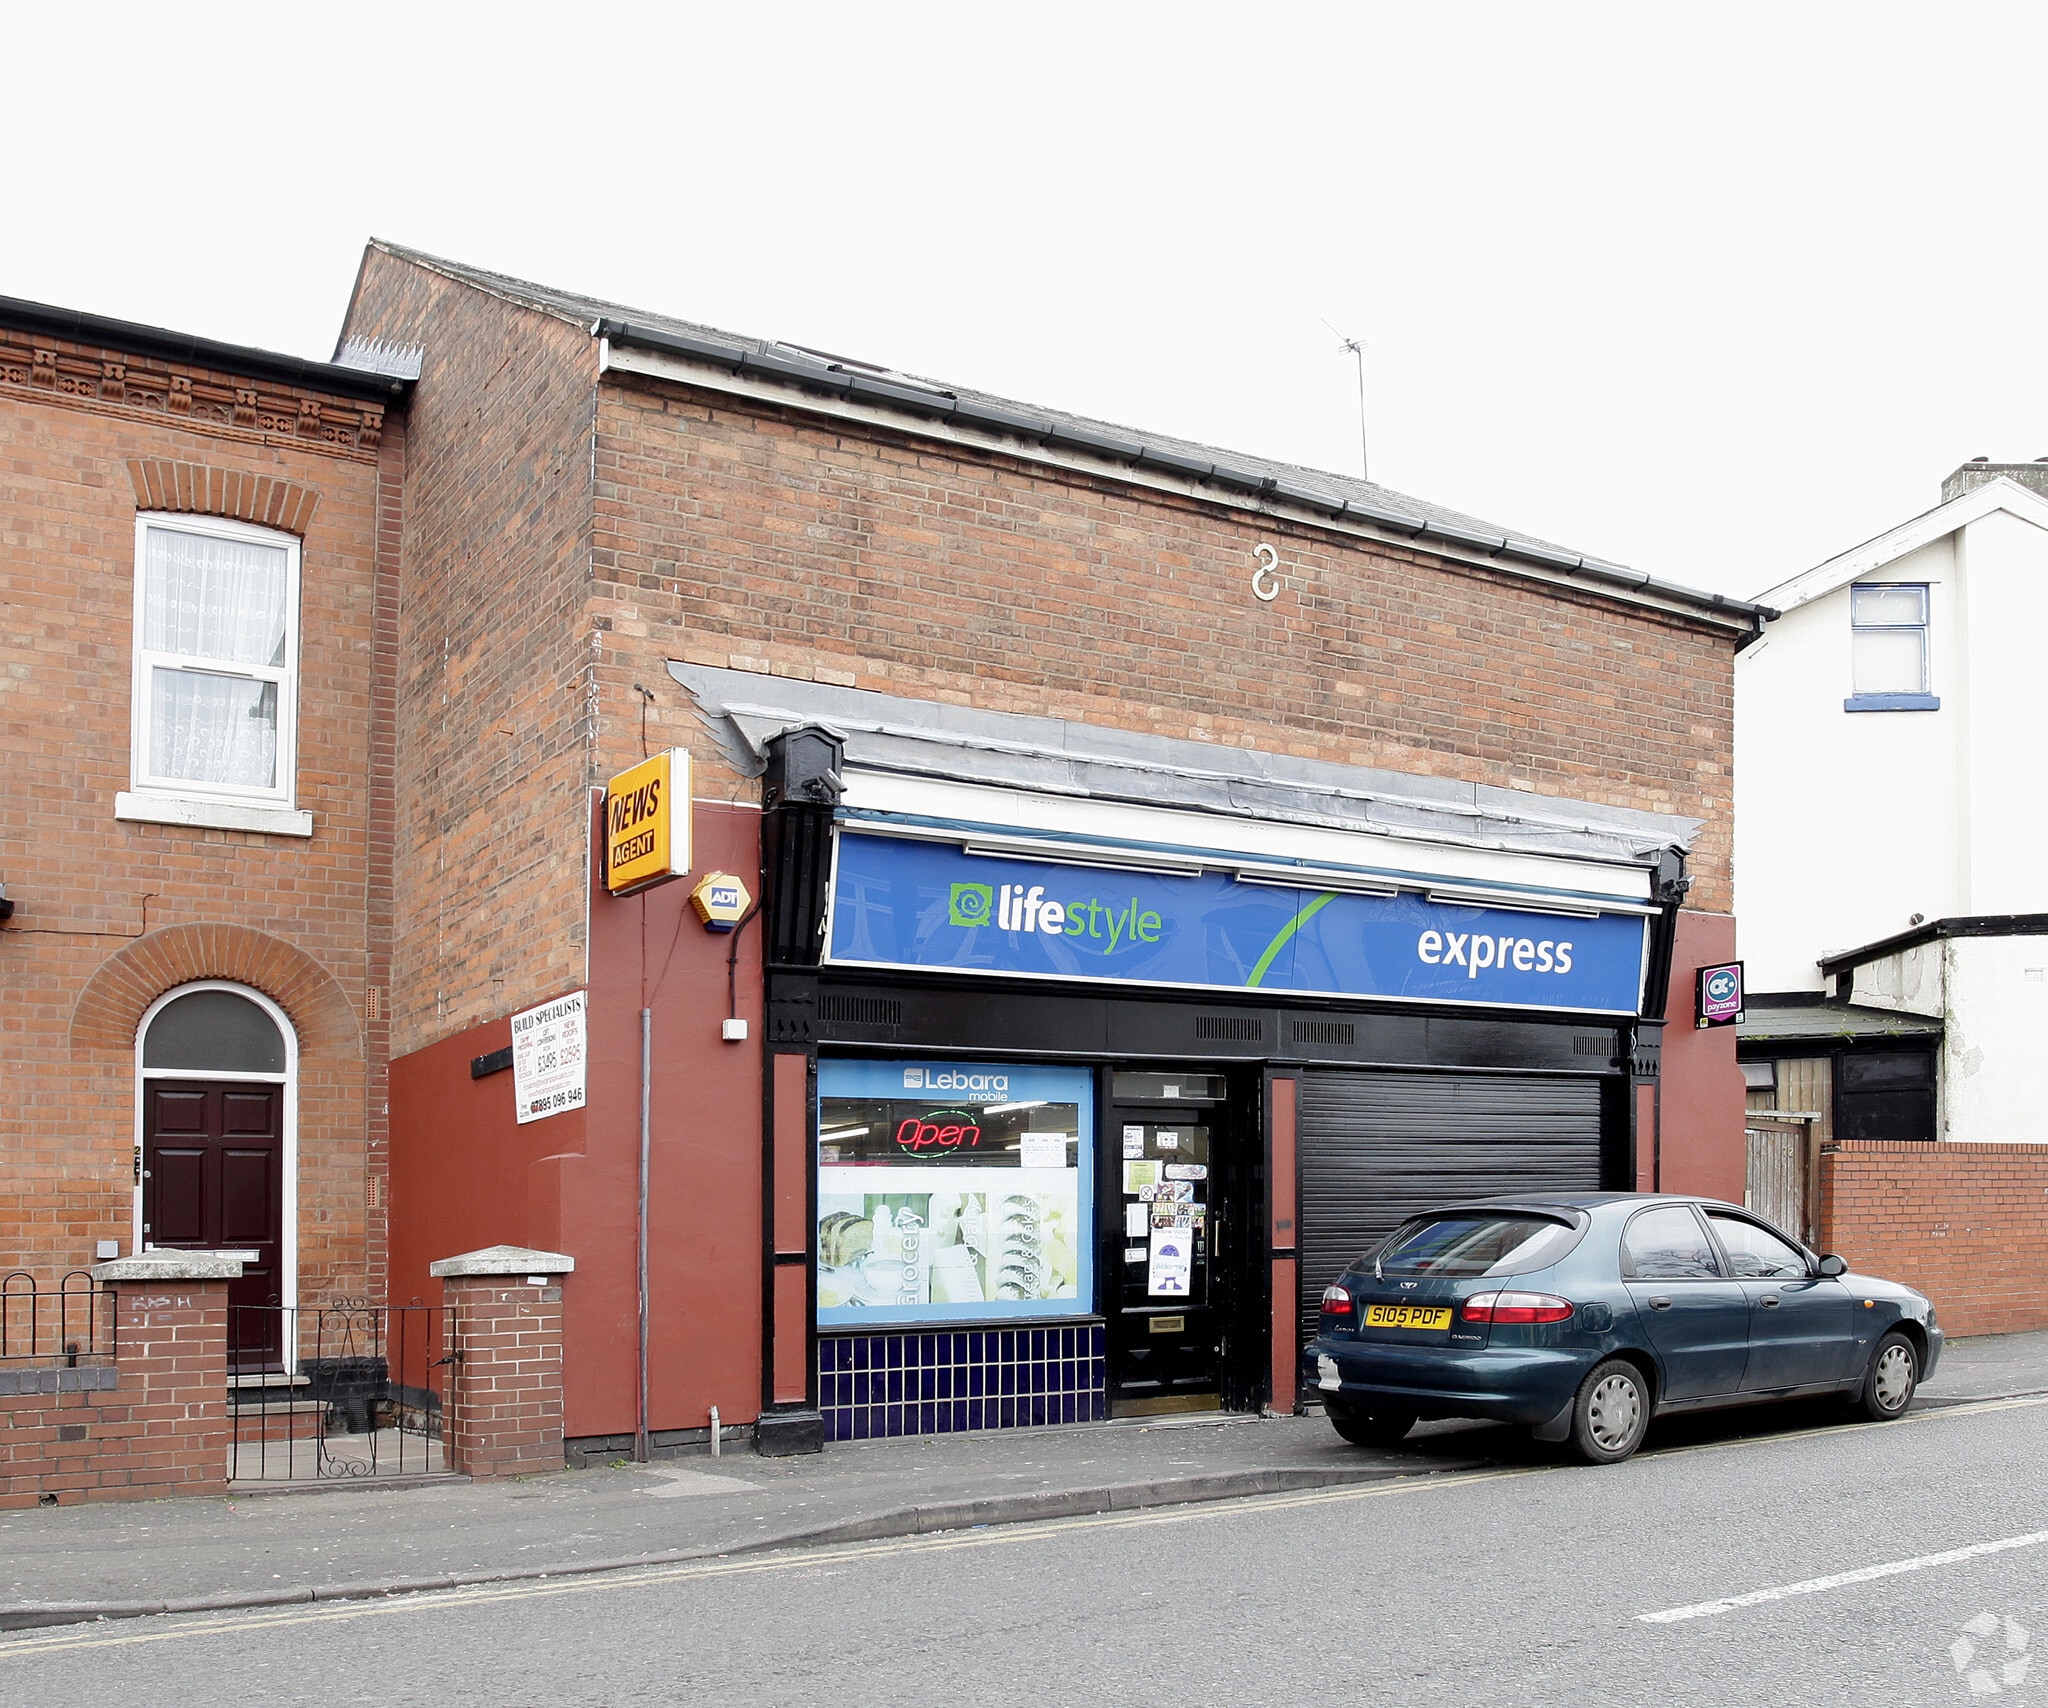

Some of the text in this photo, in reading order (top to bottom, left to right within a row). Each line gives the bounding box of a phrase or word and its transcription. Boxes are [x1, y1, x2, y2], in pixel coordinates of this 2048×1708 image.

[610, 779, 660, 836] NEWS
[614, 831, 654, 867] AGENT
[711, 890, 738, 906] ADT
[997, 883, 1162, 955] lifestyle
[1417, 929, 1574, 979] express
[514, 997, 582, 1034] BUILD SPECIALISTS
[1707, 1001, 1737, 1013] payzone
[562, 1027, 578, 1038] ROOFS
[564, 1019, 576, 1029] NEW
[538, 1051, 557, 1073] £3495
[925, 1069, 1009, 1091] Lebara
[553, 1092, 566, 1108] 096
[568, 1087, 583, 1103] 946
[968, 1091, 1009, 1102] mobile
[896, 1117, 981, 1151] Open
[964, 1204, 981, 1248] Dairy
[897, 1210, 925, 1305] Grocery
[966, 1253, 979, 1266] &
[1021, 1200, 1034, 1300] read & Cakes
[1372, 1307, 1446, 1325] S105 PDF
